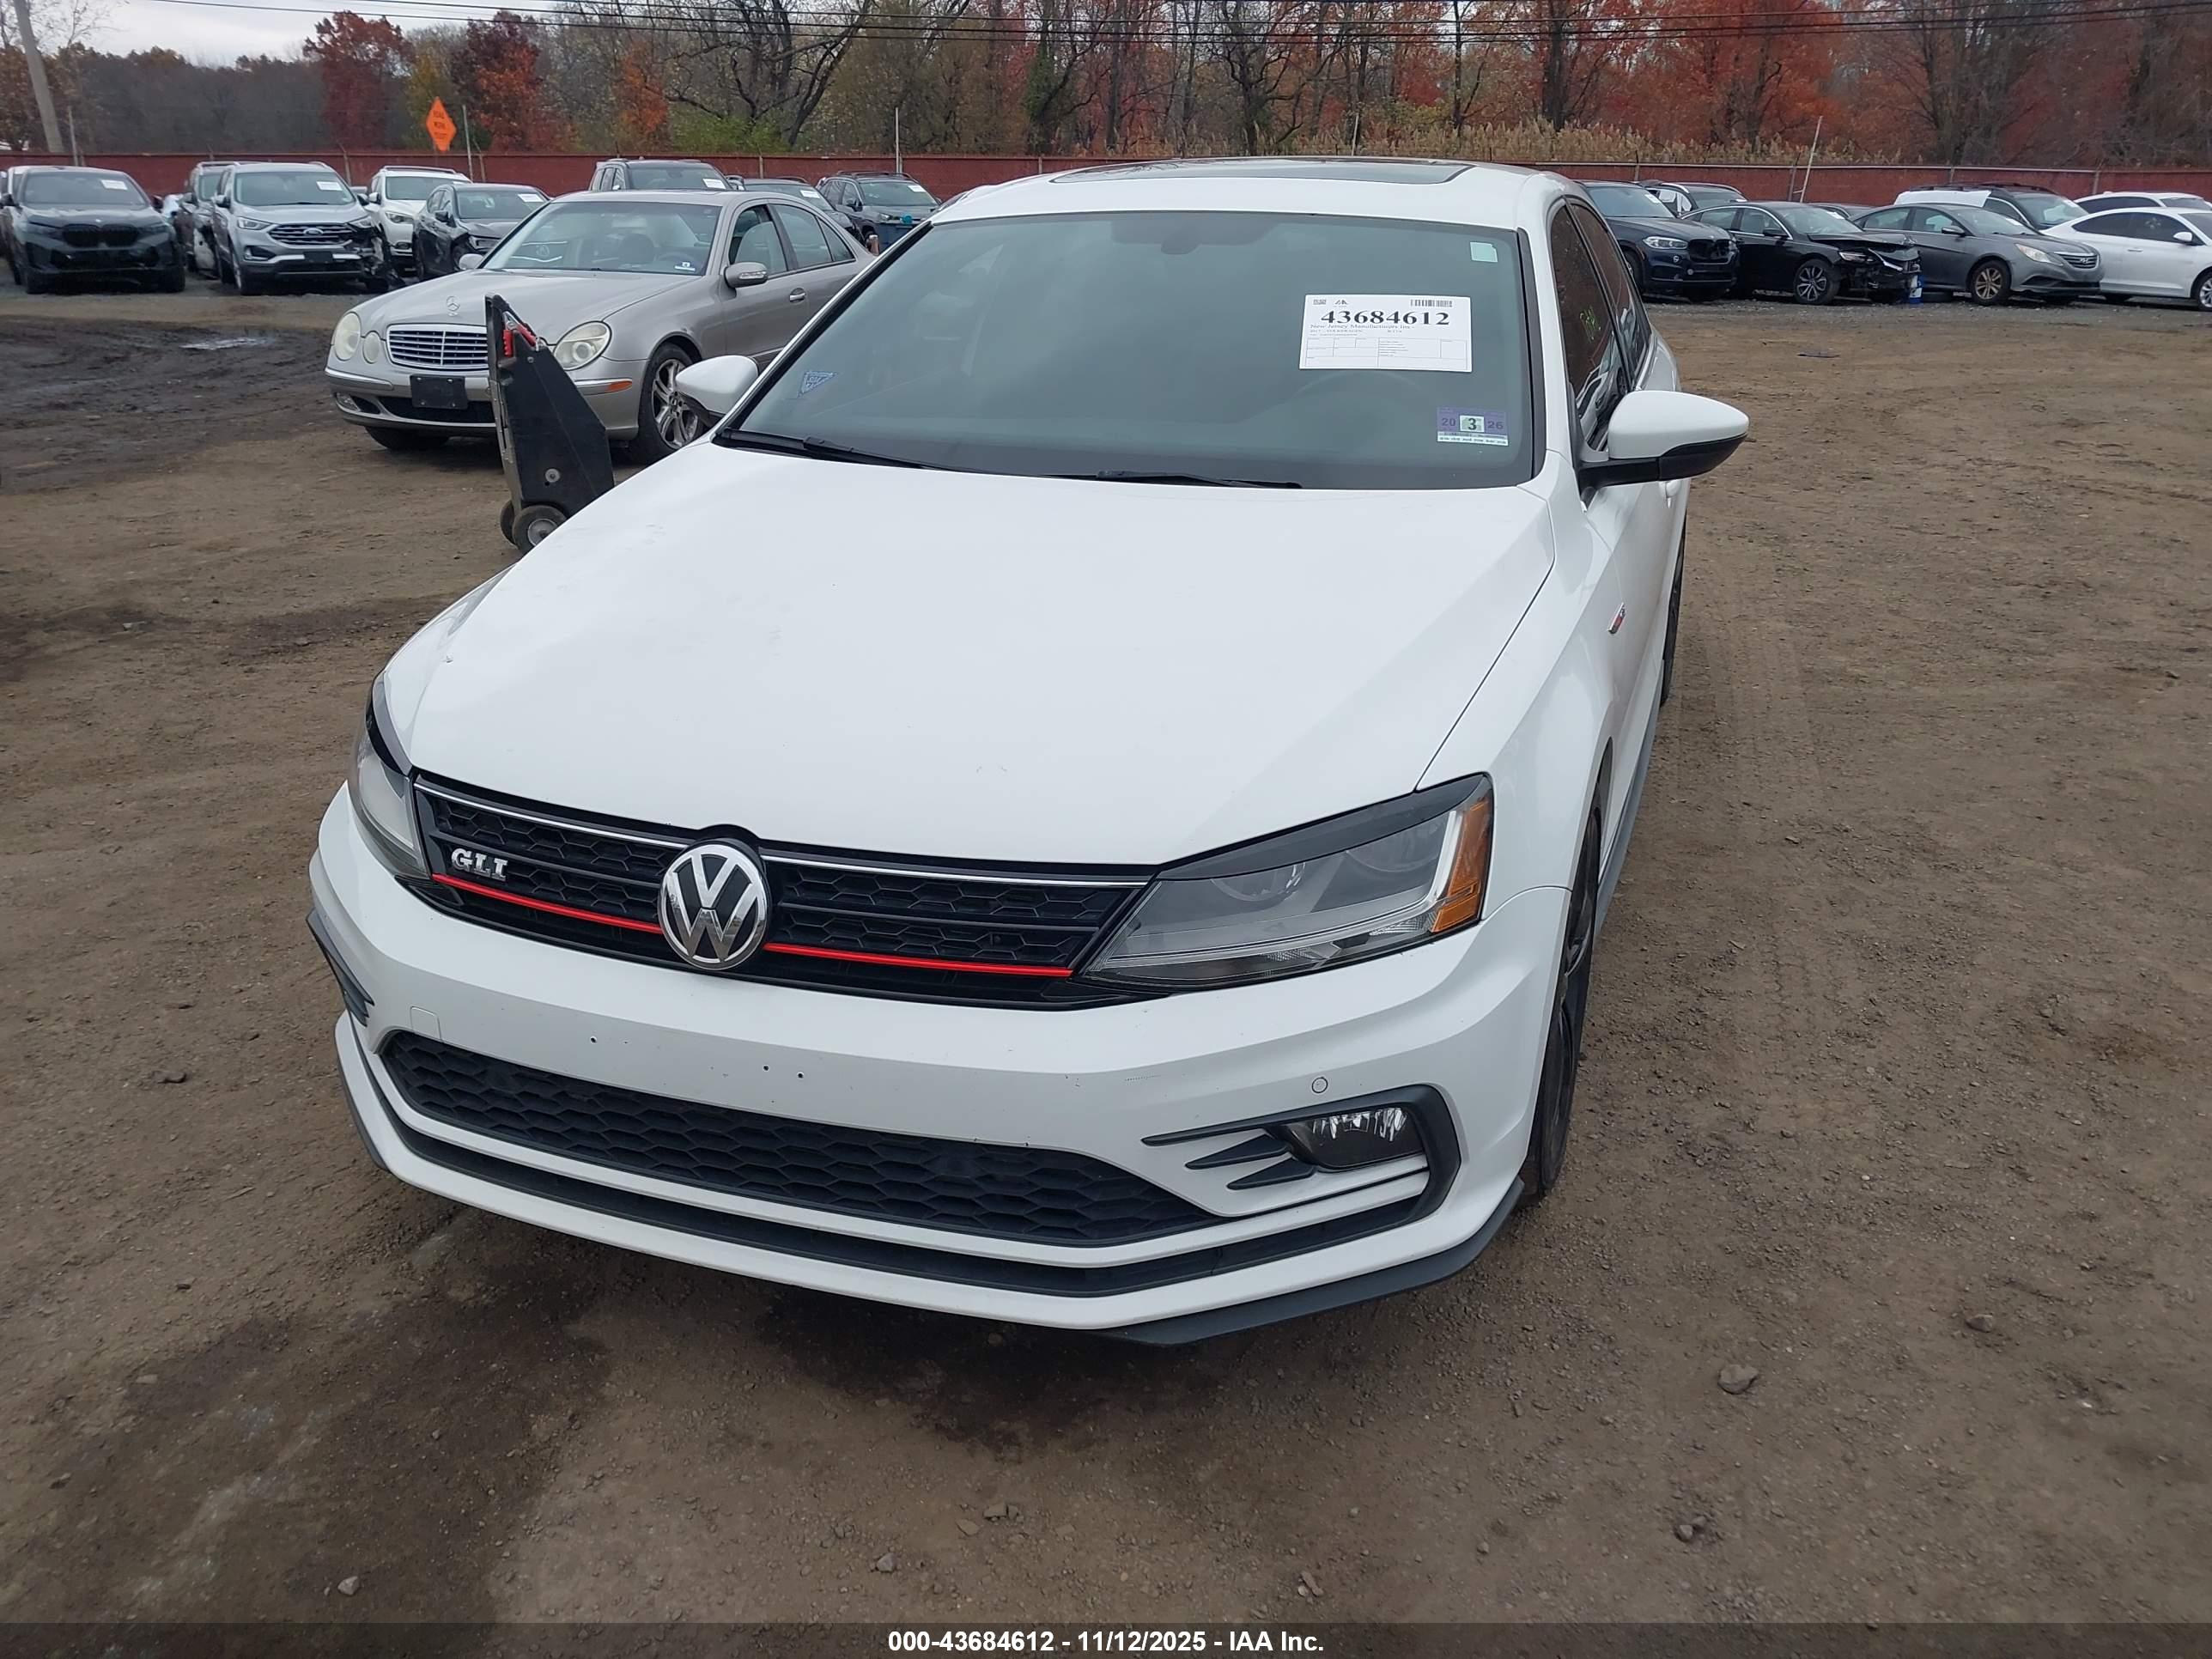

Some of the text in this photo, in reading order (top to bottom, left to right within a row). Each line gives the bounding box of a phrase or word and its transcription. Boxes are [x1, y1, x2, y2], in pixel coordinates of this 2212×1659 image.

[1321, 310, 1450, 325] 43684612
[1468, 417, 1477, 430] 3
[451, 848, 508, 882] GLI
